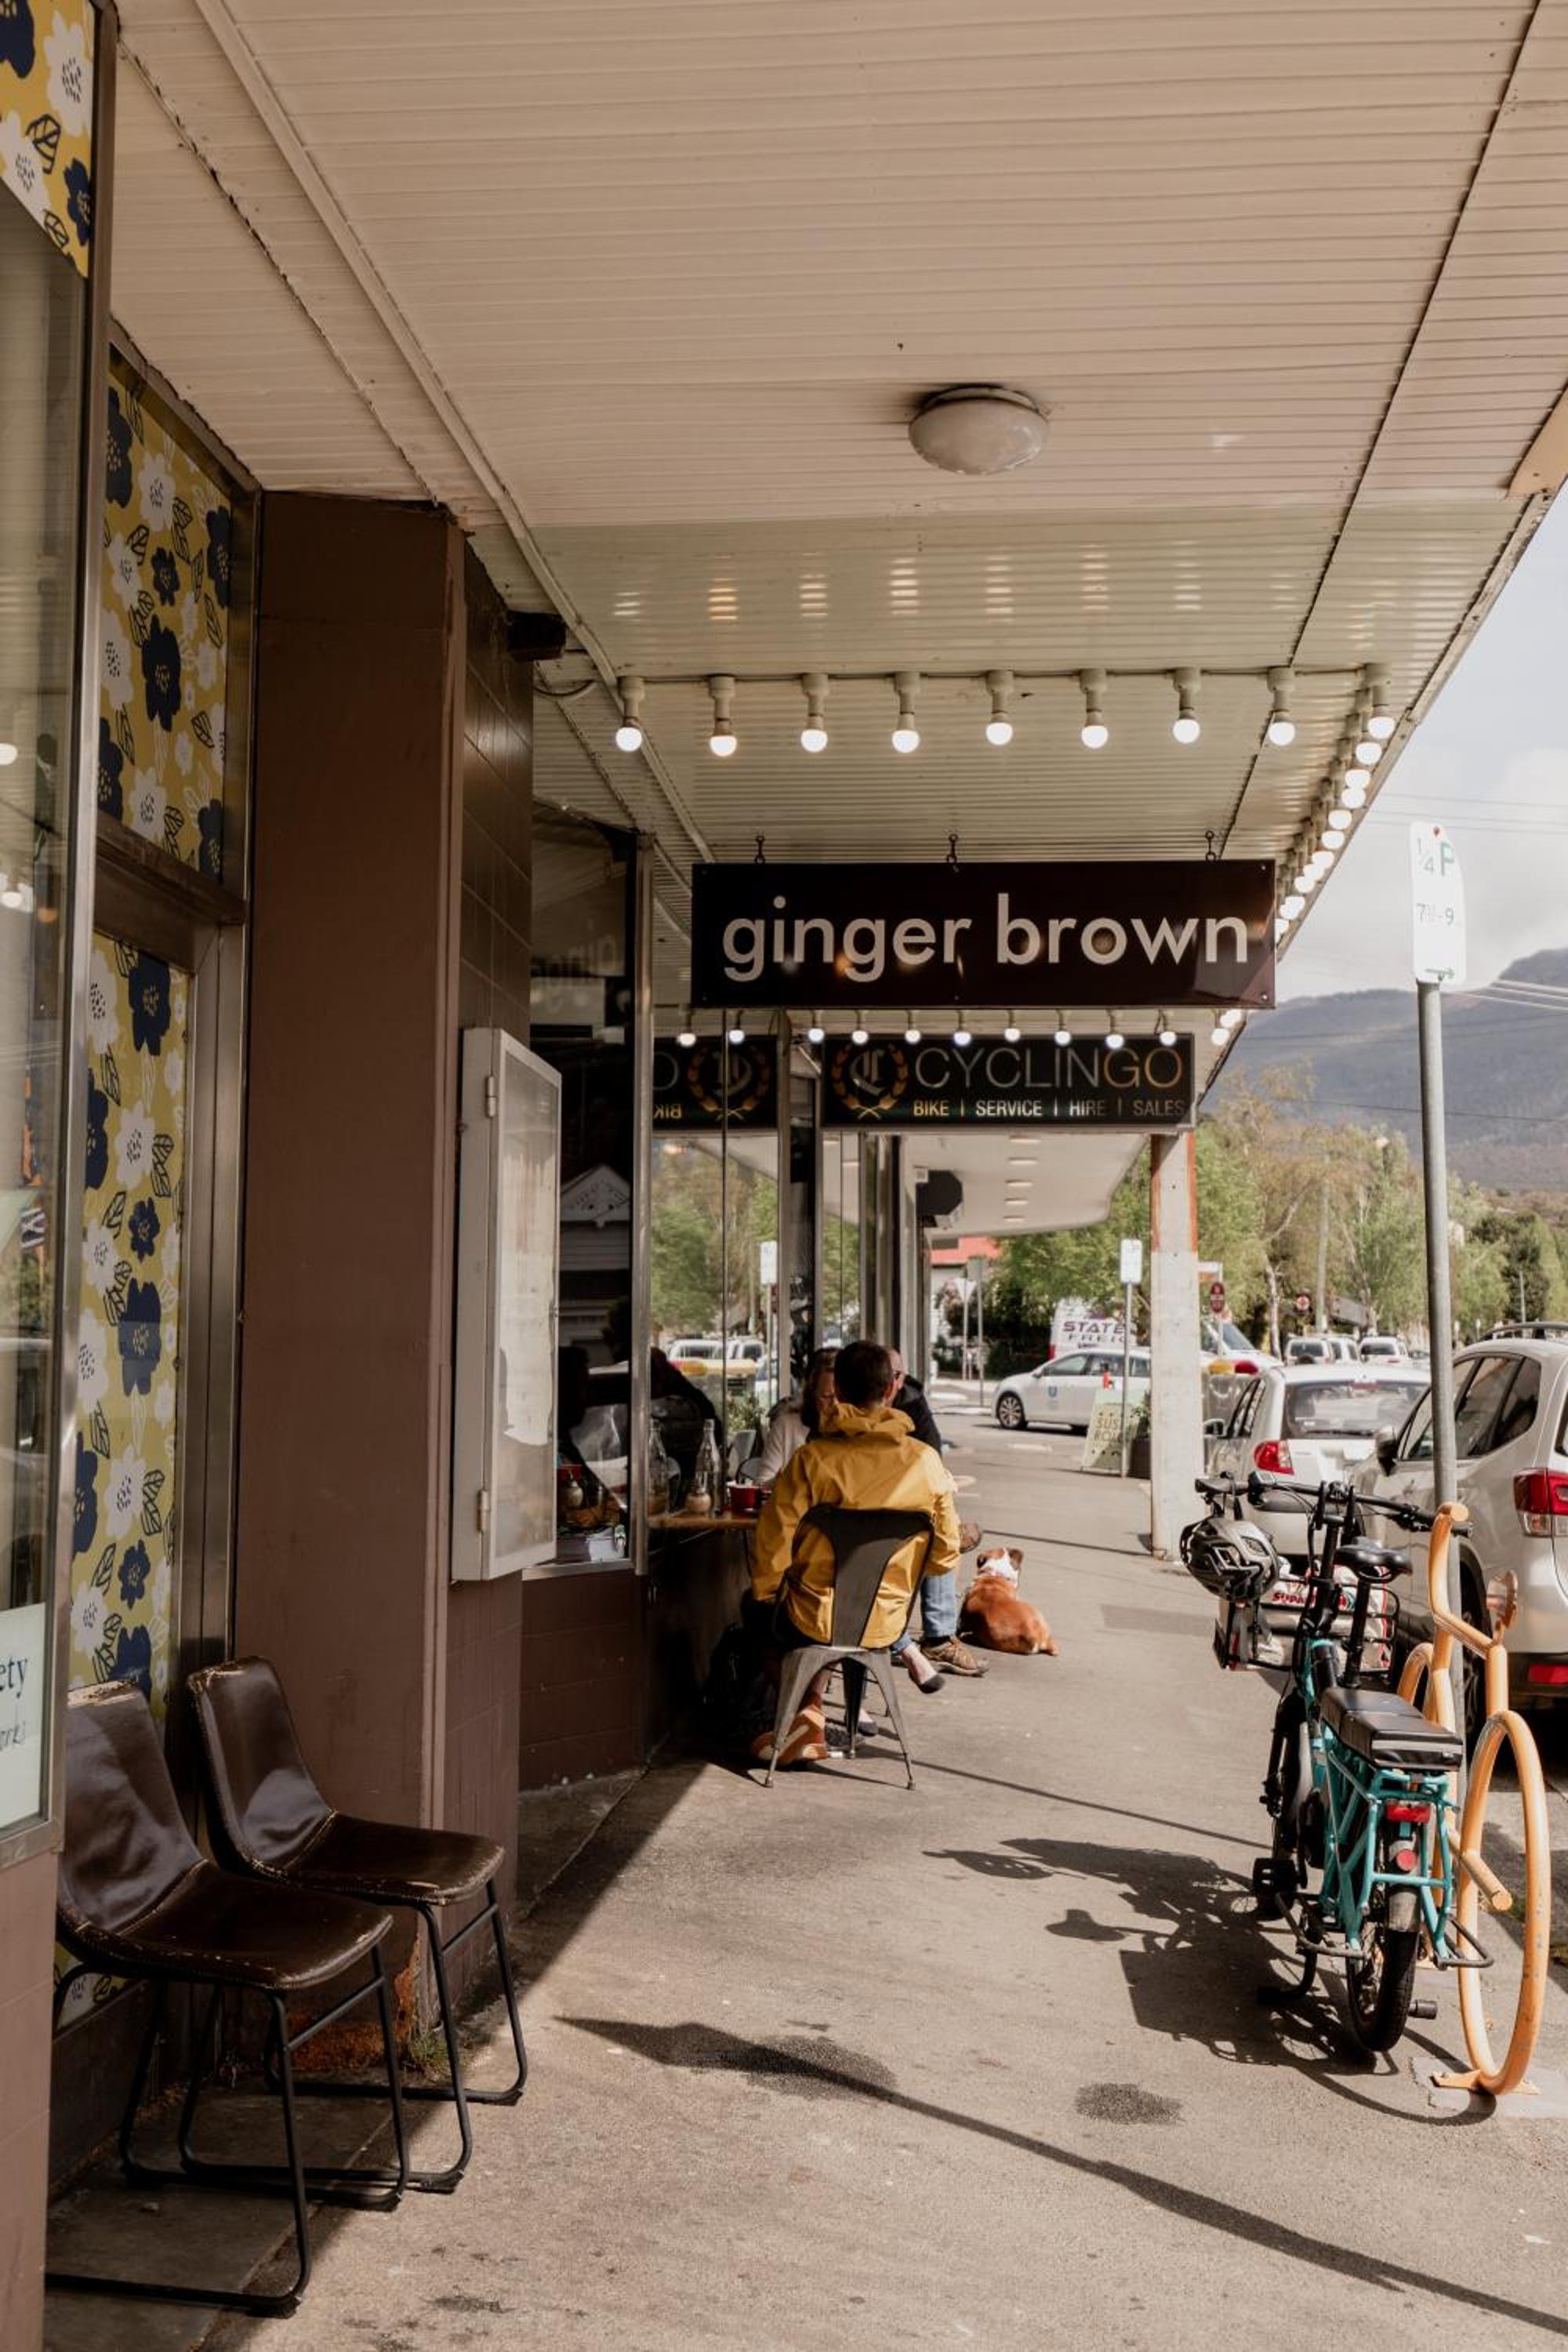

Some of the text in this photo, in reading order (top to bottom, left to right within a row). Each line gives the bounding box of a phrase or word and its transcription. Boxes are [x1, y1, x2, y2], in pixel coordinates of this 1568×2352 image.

[723, 893, 1248, 982] ginger brown
[915, 1047, 1183, 1089] CYCLINGO
[913, 1099, 1185, 1117] BIKE SERVICE HIRE SALES
